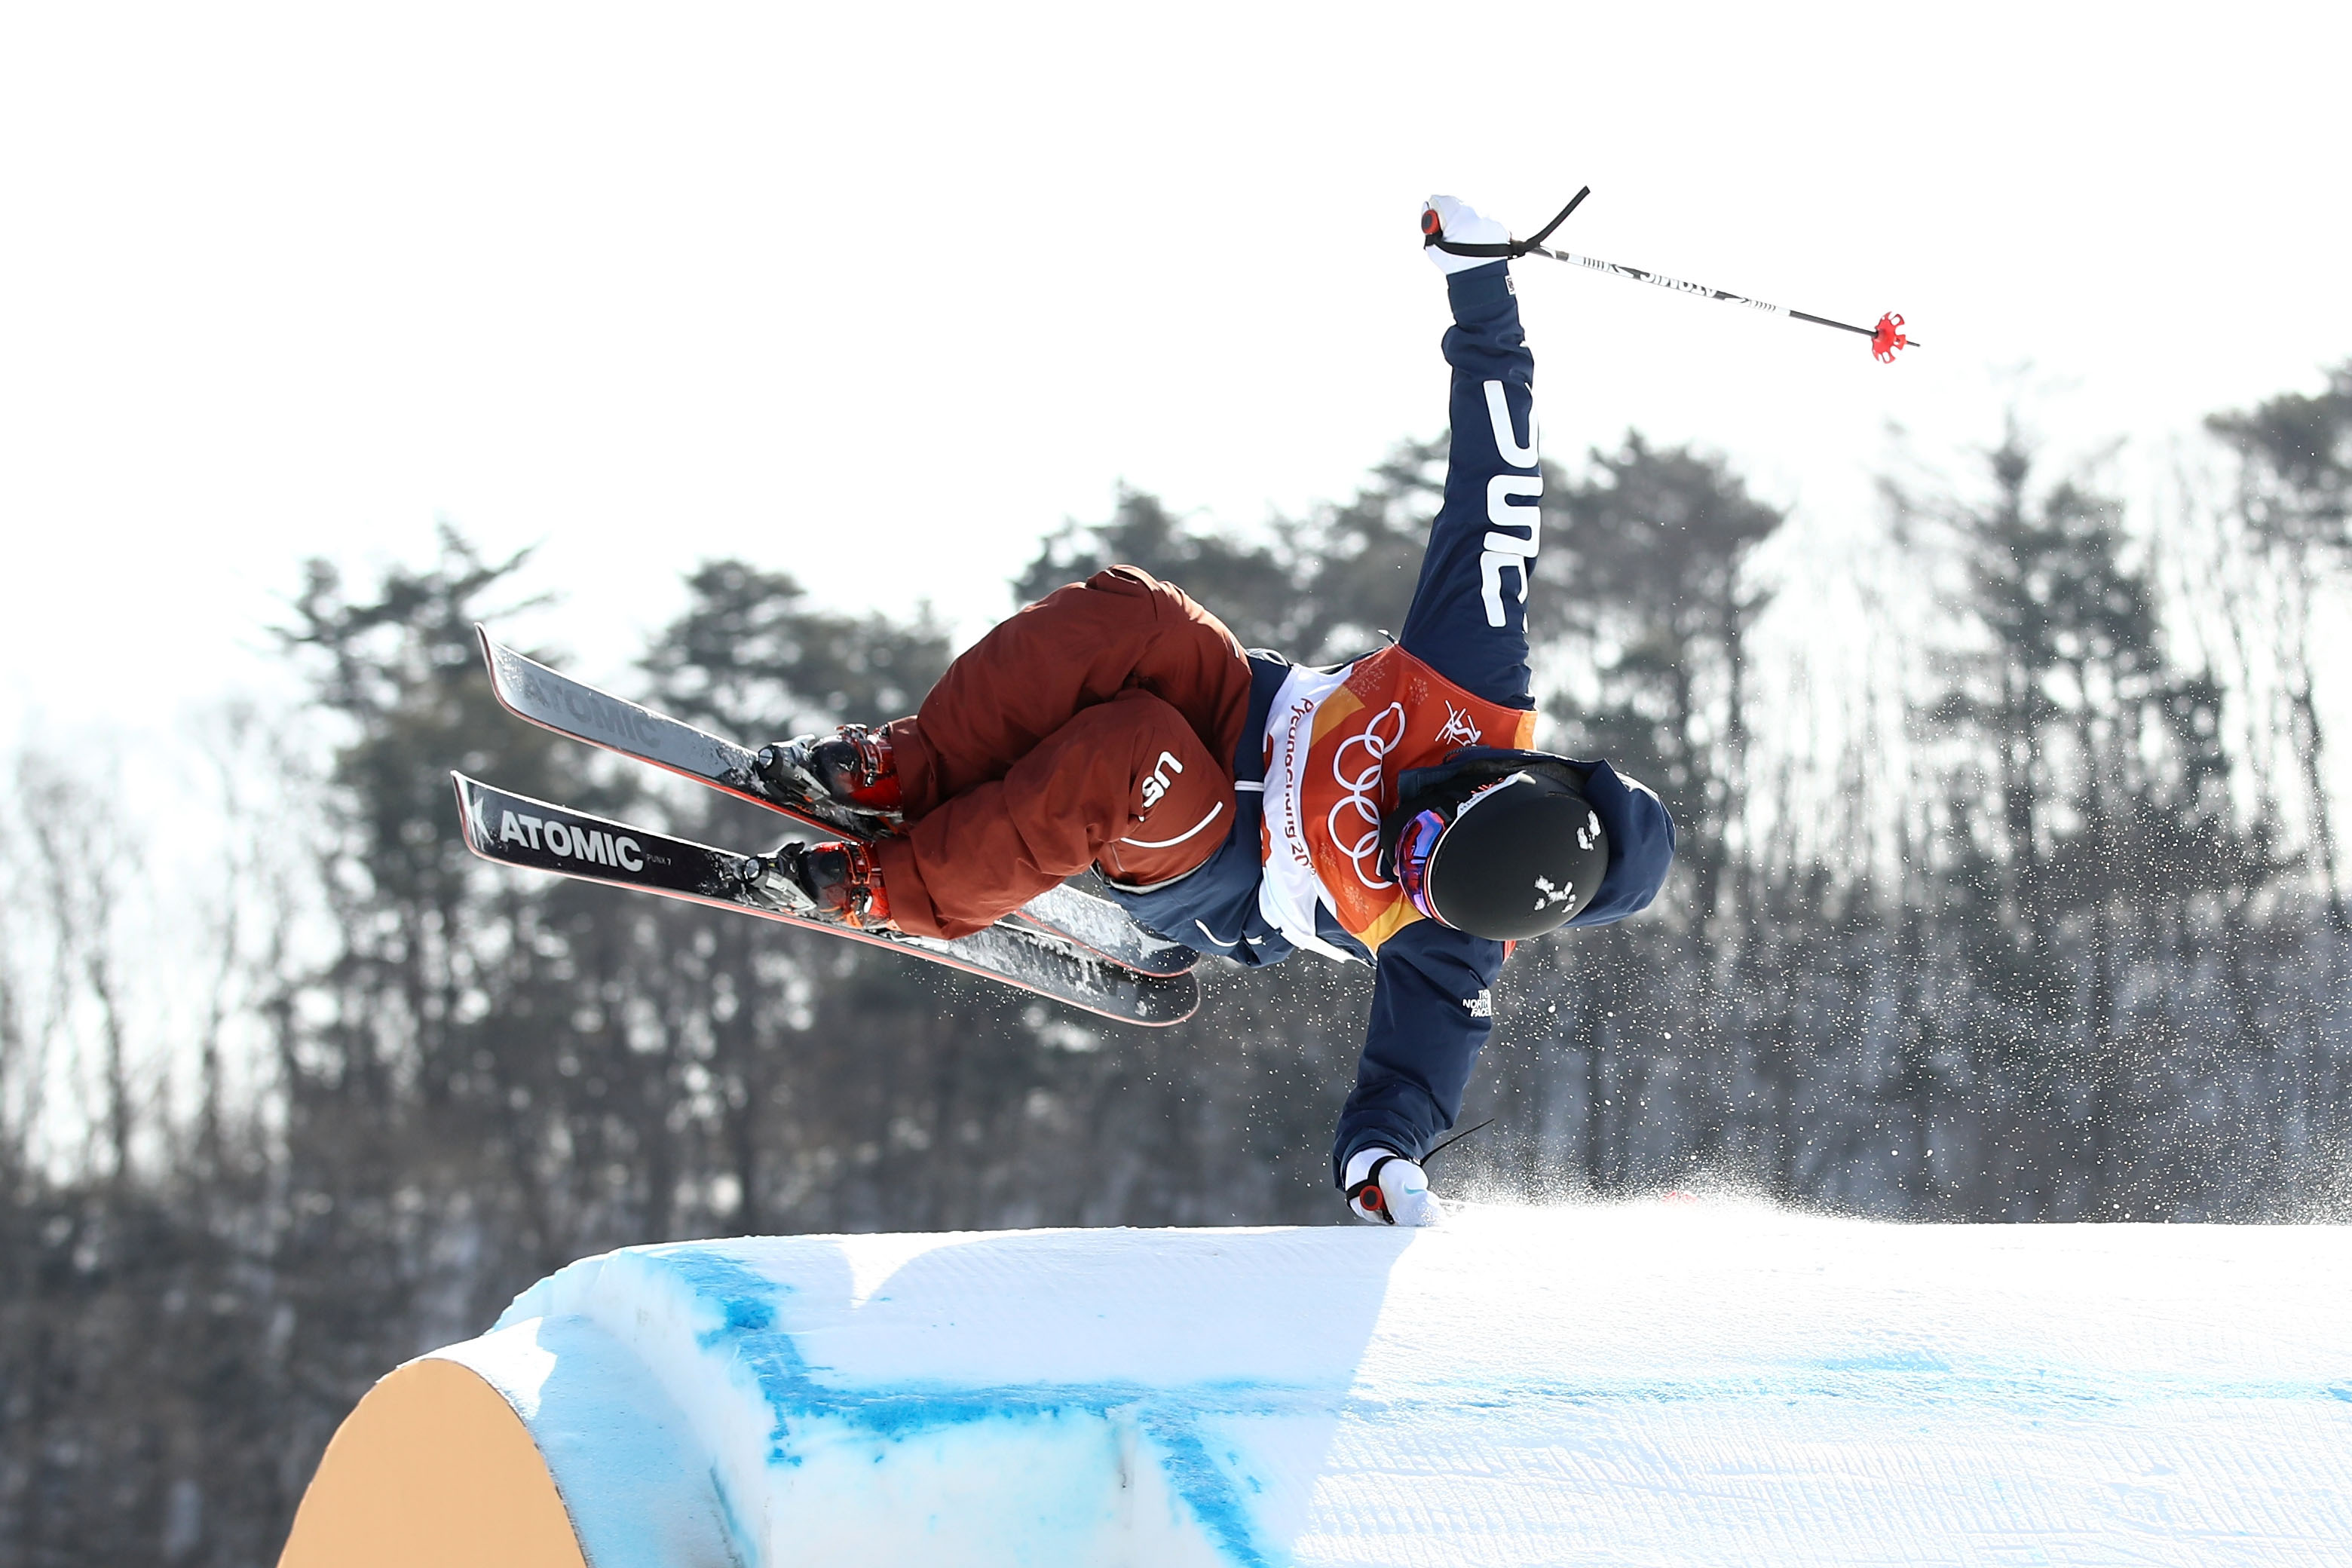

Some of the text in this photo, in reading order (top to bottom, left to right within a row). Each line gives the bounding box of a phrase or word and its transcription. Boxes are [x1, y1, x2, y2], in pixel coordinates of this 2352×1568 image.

[523, 670, 661, 749] ATOMIC
[1138, 751, 1184, 822] US
[500, 810, 644, 872] ATOMIC
[1462, 998, 1489, 1009] NORTH
[1471, 1007, 1489, 1018] FACE
